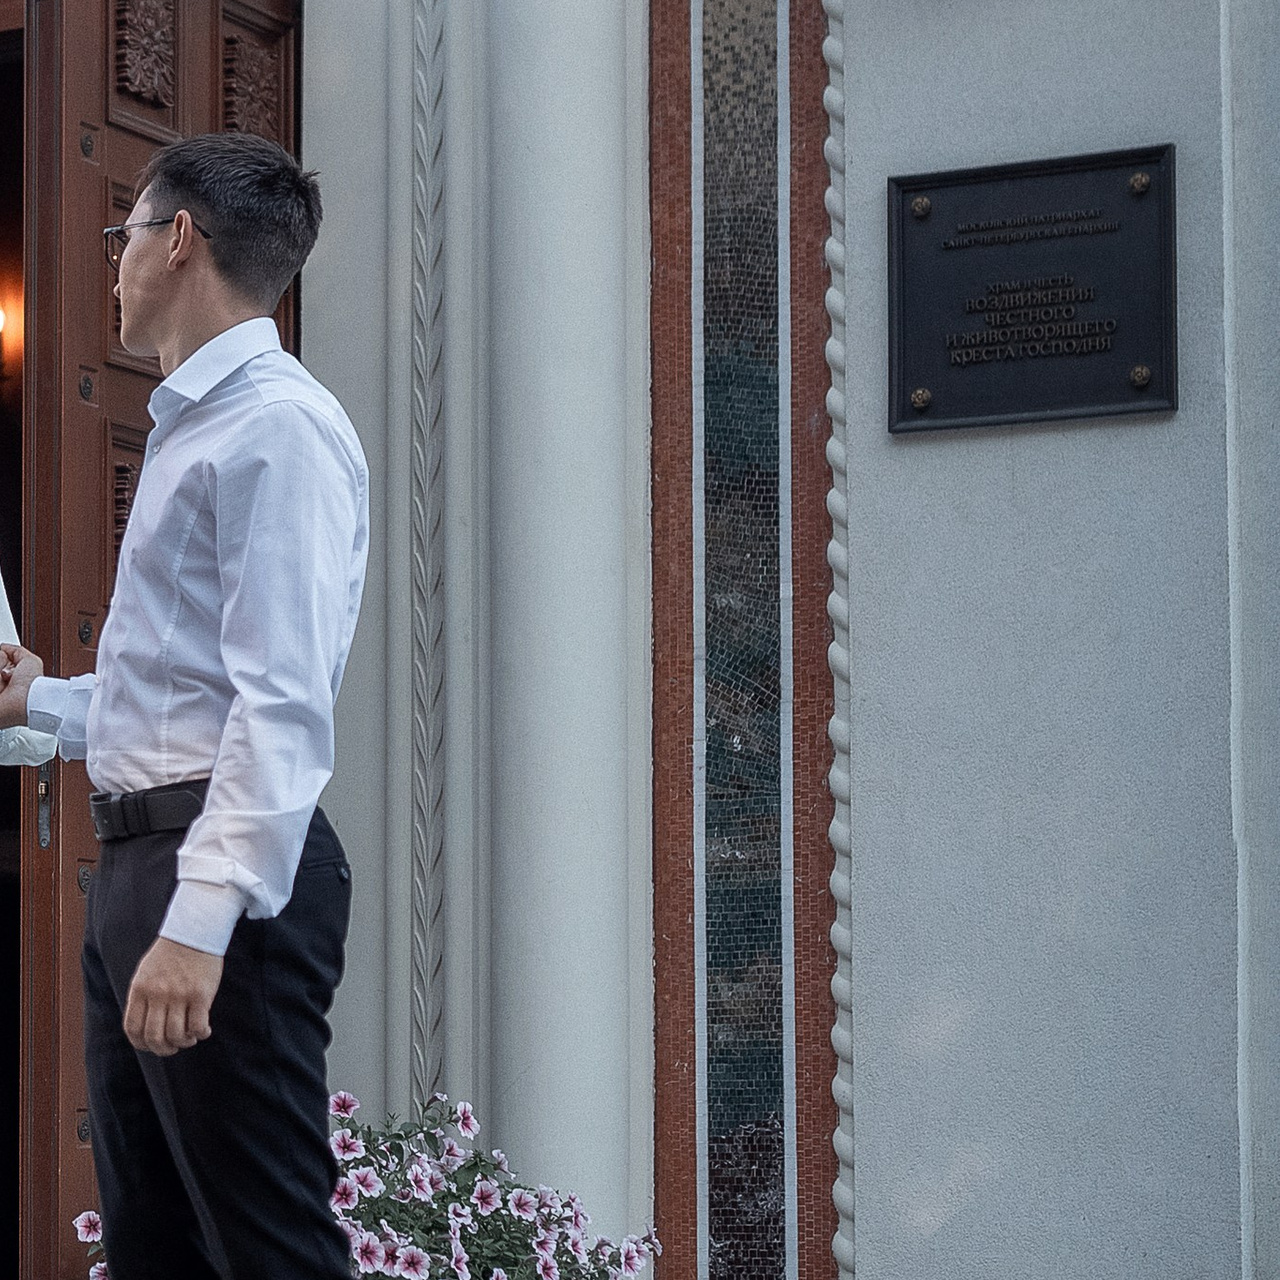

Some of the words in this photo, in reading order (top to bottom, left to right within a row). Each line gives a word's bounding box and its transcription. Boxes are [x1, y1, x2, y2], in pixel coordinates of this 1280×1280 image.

[965, 286, 1095, 312] ВОЗДВИЖЕНИЯ
[984, 305, 1076, 326] ЧЕСТНОГО
[945, 333, 958, 347] И
[961, 318, 1117, 345] ЖИВОТВОРЯЩЕГО
[950, 345, 1016, 365] КРЕСТА
[1018, 335, 1112, 358] ГОСПОДНЯ
